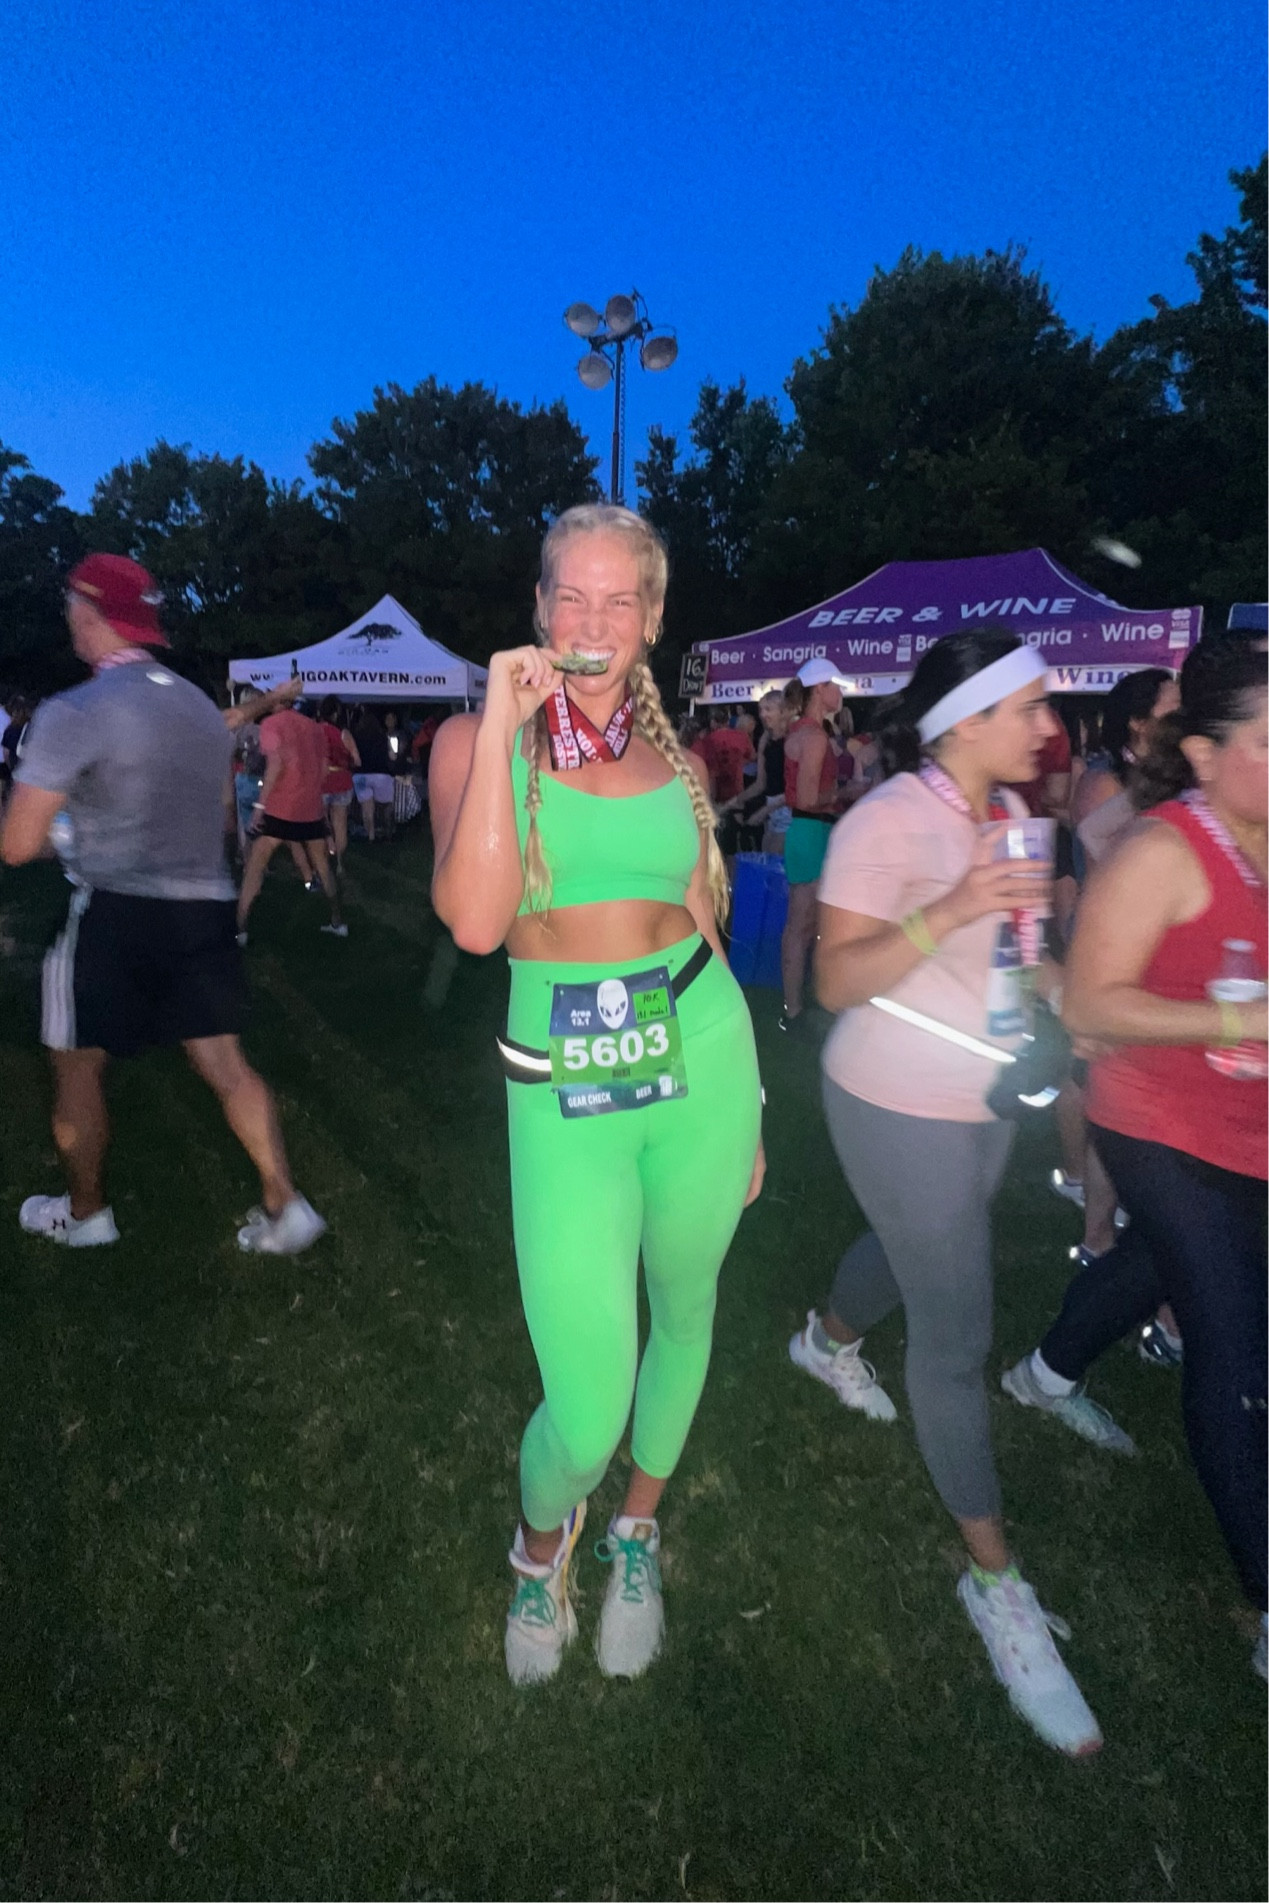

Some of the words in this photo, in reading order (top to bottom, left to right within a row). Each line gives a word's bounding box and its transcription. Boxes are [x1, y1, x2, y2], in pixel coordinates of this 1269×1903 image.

[808, 607, 903, 628] BEER
[912, 606, 943, 622] &
[960, 597, 1076, 619] WINE
[711, 649, 745, 665] Beer
[763, 644, 827, 664] Sangria
[847, 638, 893, 656] Wine
[1101, 621, 1164, 642] Wine
[686, 658, 701, 677] 16
[711, 683, 755, 698] Beer
[571, 1017, 590, 1026] 13.1
[563, 1023, 669, 1071] 5603
[567, 1095, 587, 1108] GEAR
[588, 1091, 612, 1106] CHECK
[635, 1085, 652, 1100] BEER
